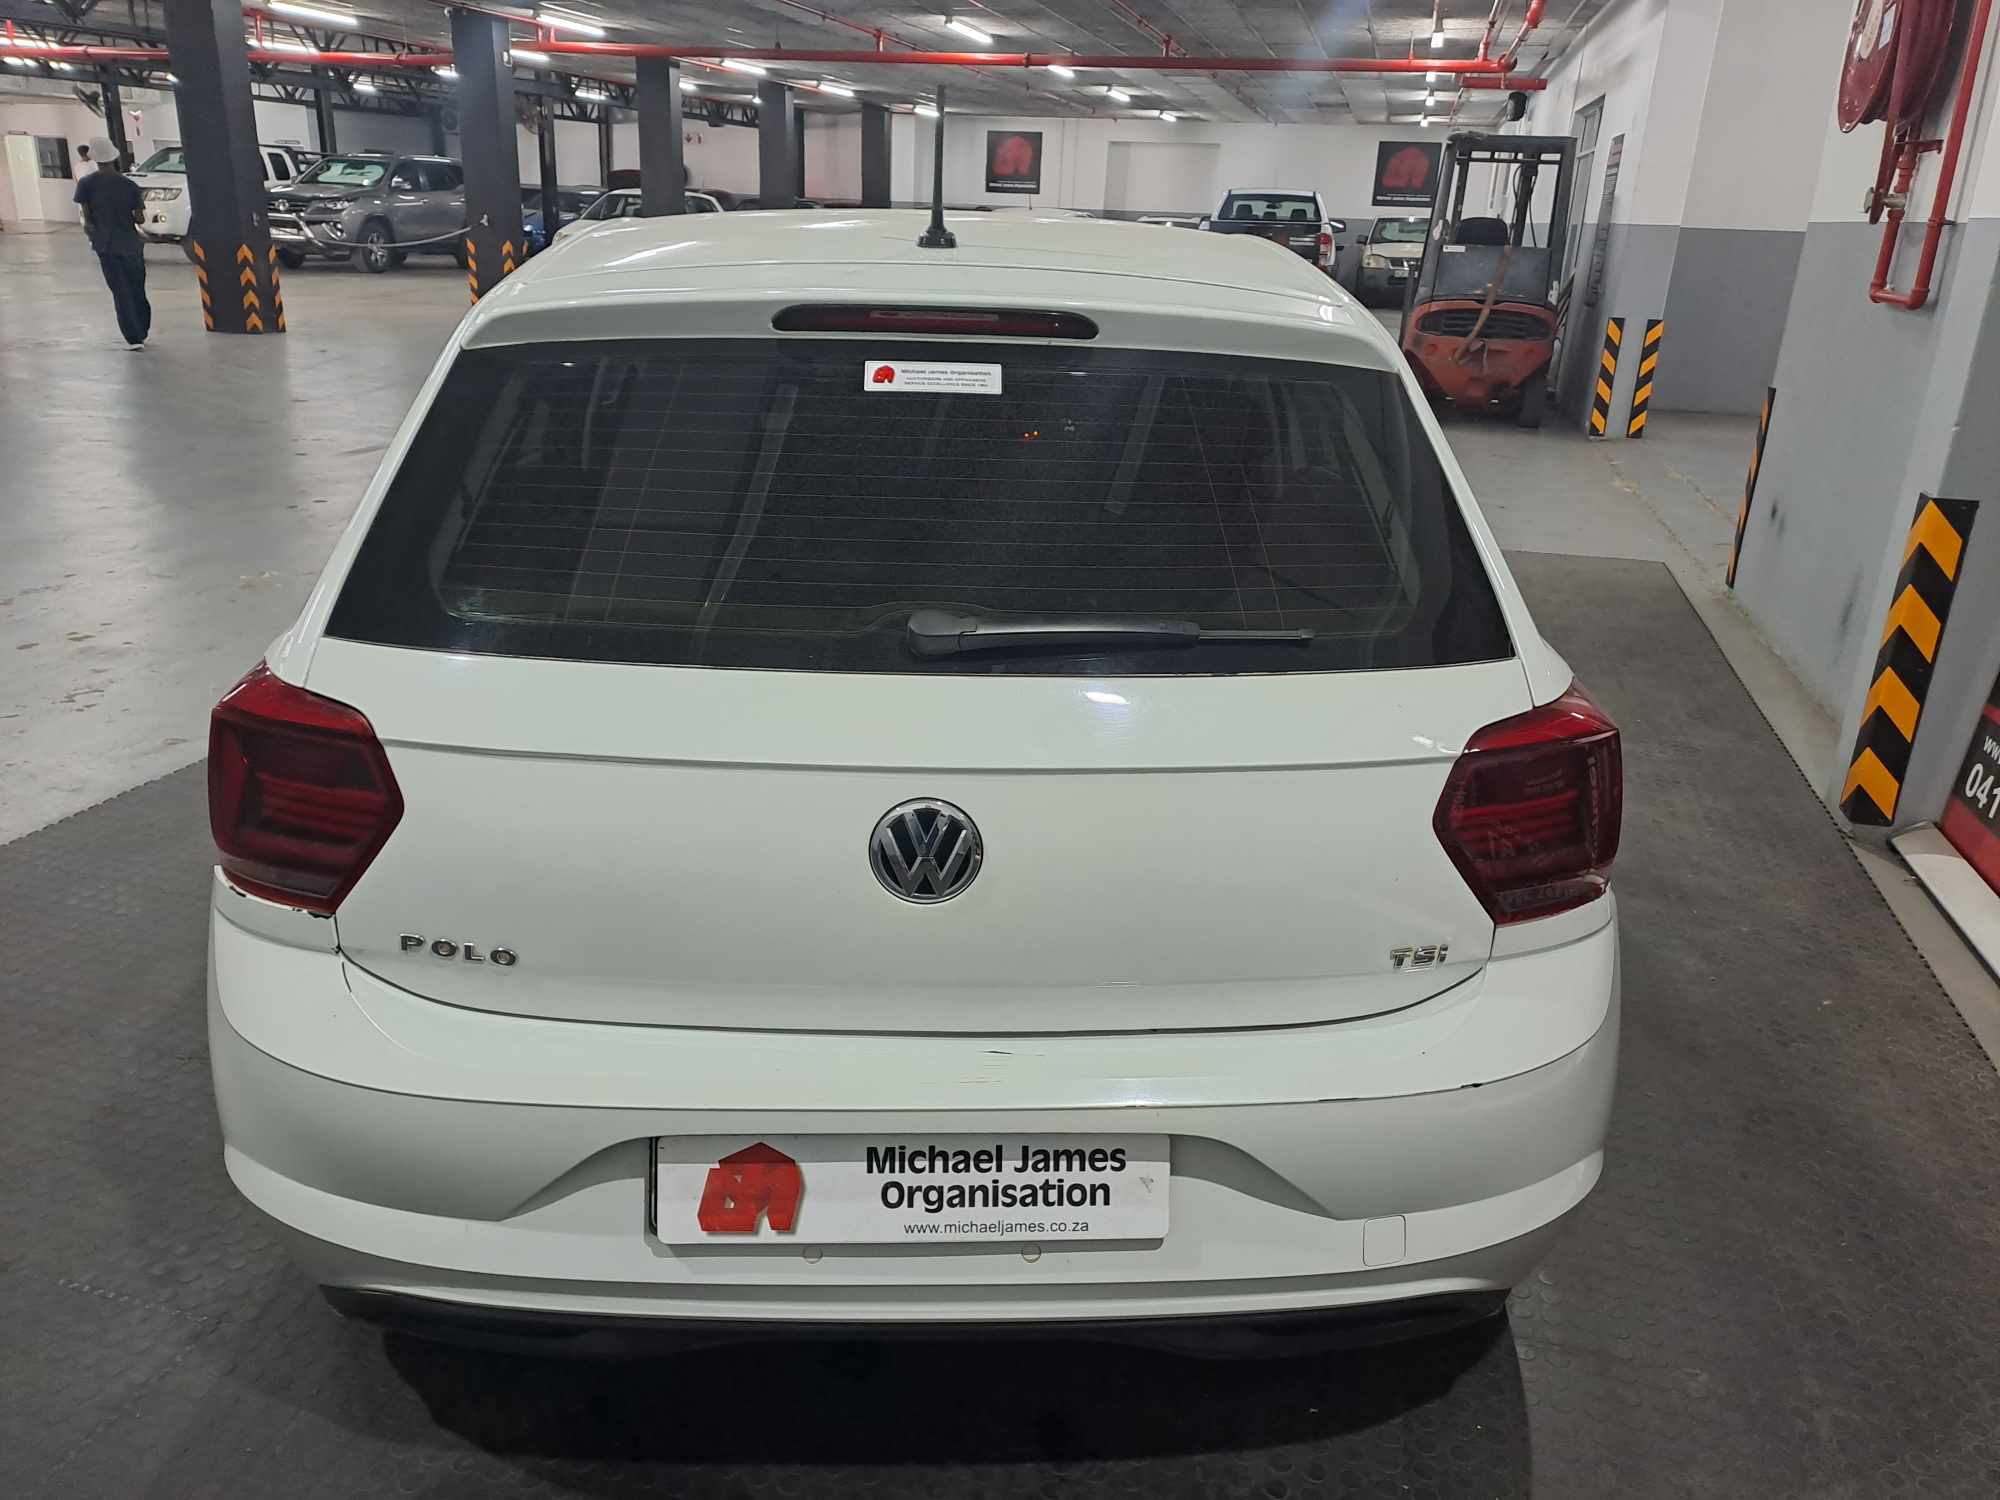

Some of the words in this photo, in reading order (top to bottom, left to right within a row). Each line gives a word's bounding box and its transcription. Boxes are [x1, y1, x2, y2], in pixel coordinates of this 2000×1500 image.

[1965, 763, 2000, 819] 041
[400, 933, 519, 967] POLO
[866, 1145, 1003, 1174] Michael
[1014, 1145, 1127, 1173] James
[881, 1179, 1111, 1214] Organisation
[904, 1220, 1089, 1236] www.michaeljames.co.za
